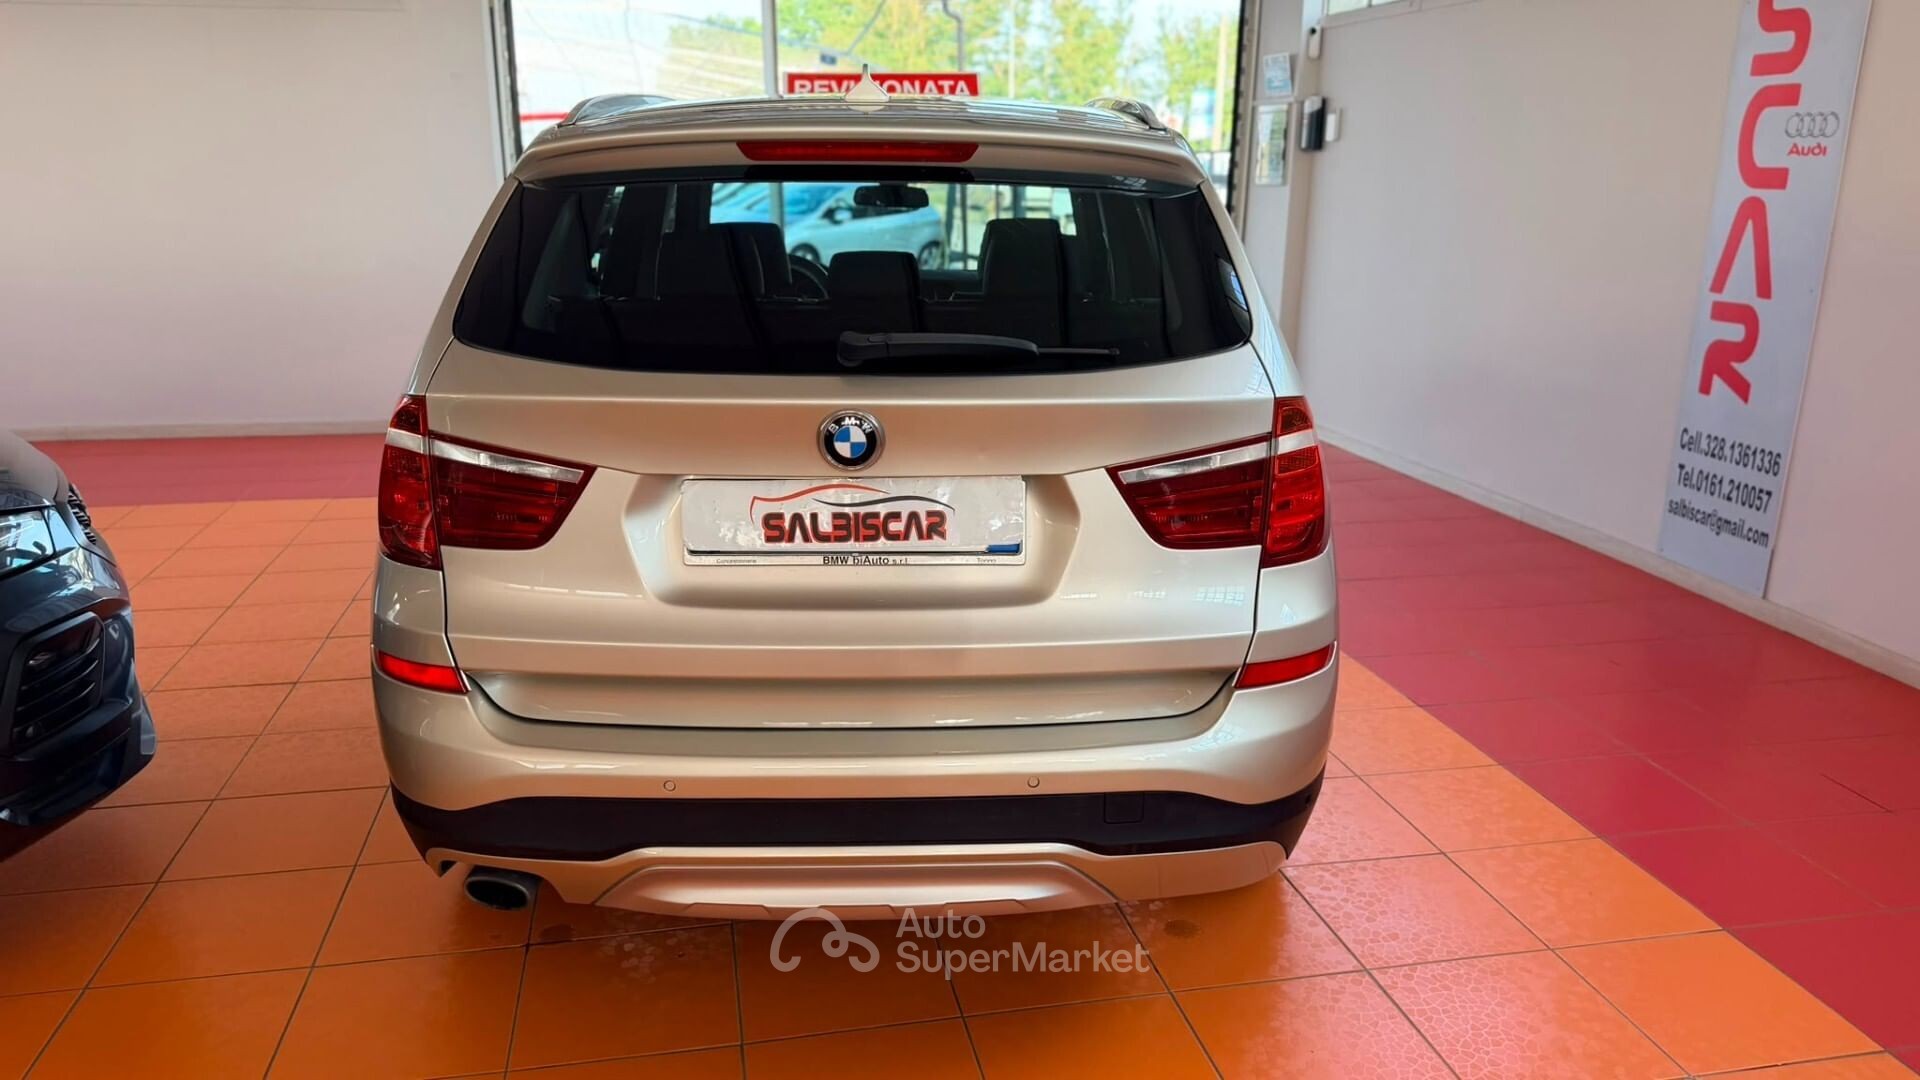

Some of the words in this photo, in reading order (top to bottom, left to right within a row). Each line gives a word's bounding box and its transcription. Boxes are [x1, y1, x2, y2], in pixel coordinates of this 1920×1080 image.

[1787, 142, 1827, 157] Audi
[829, 417, 872, 434] BMW
[1680, 427, 1782, 477] Cell.328.1361336
[1677, 463, 1773, 514] Tel.0161.210057
[761, 510, 947, 544] SALBISCAR
[1667, 498, 1770, 549] salbiscar@gmail.com
[822, 556, 849, 566] BMW
